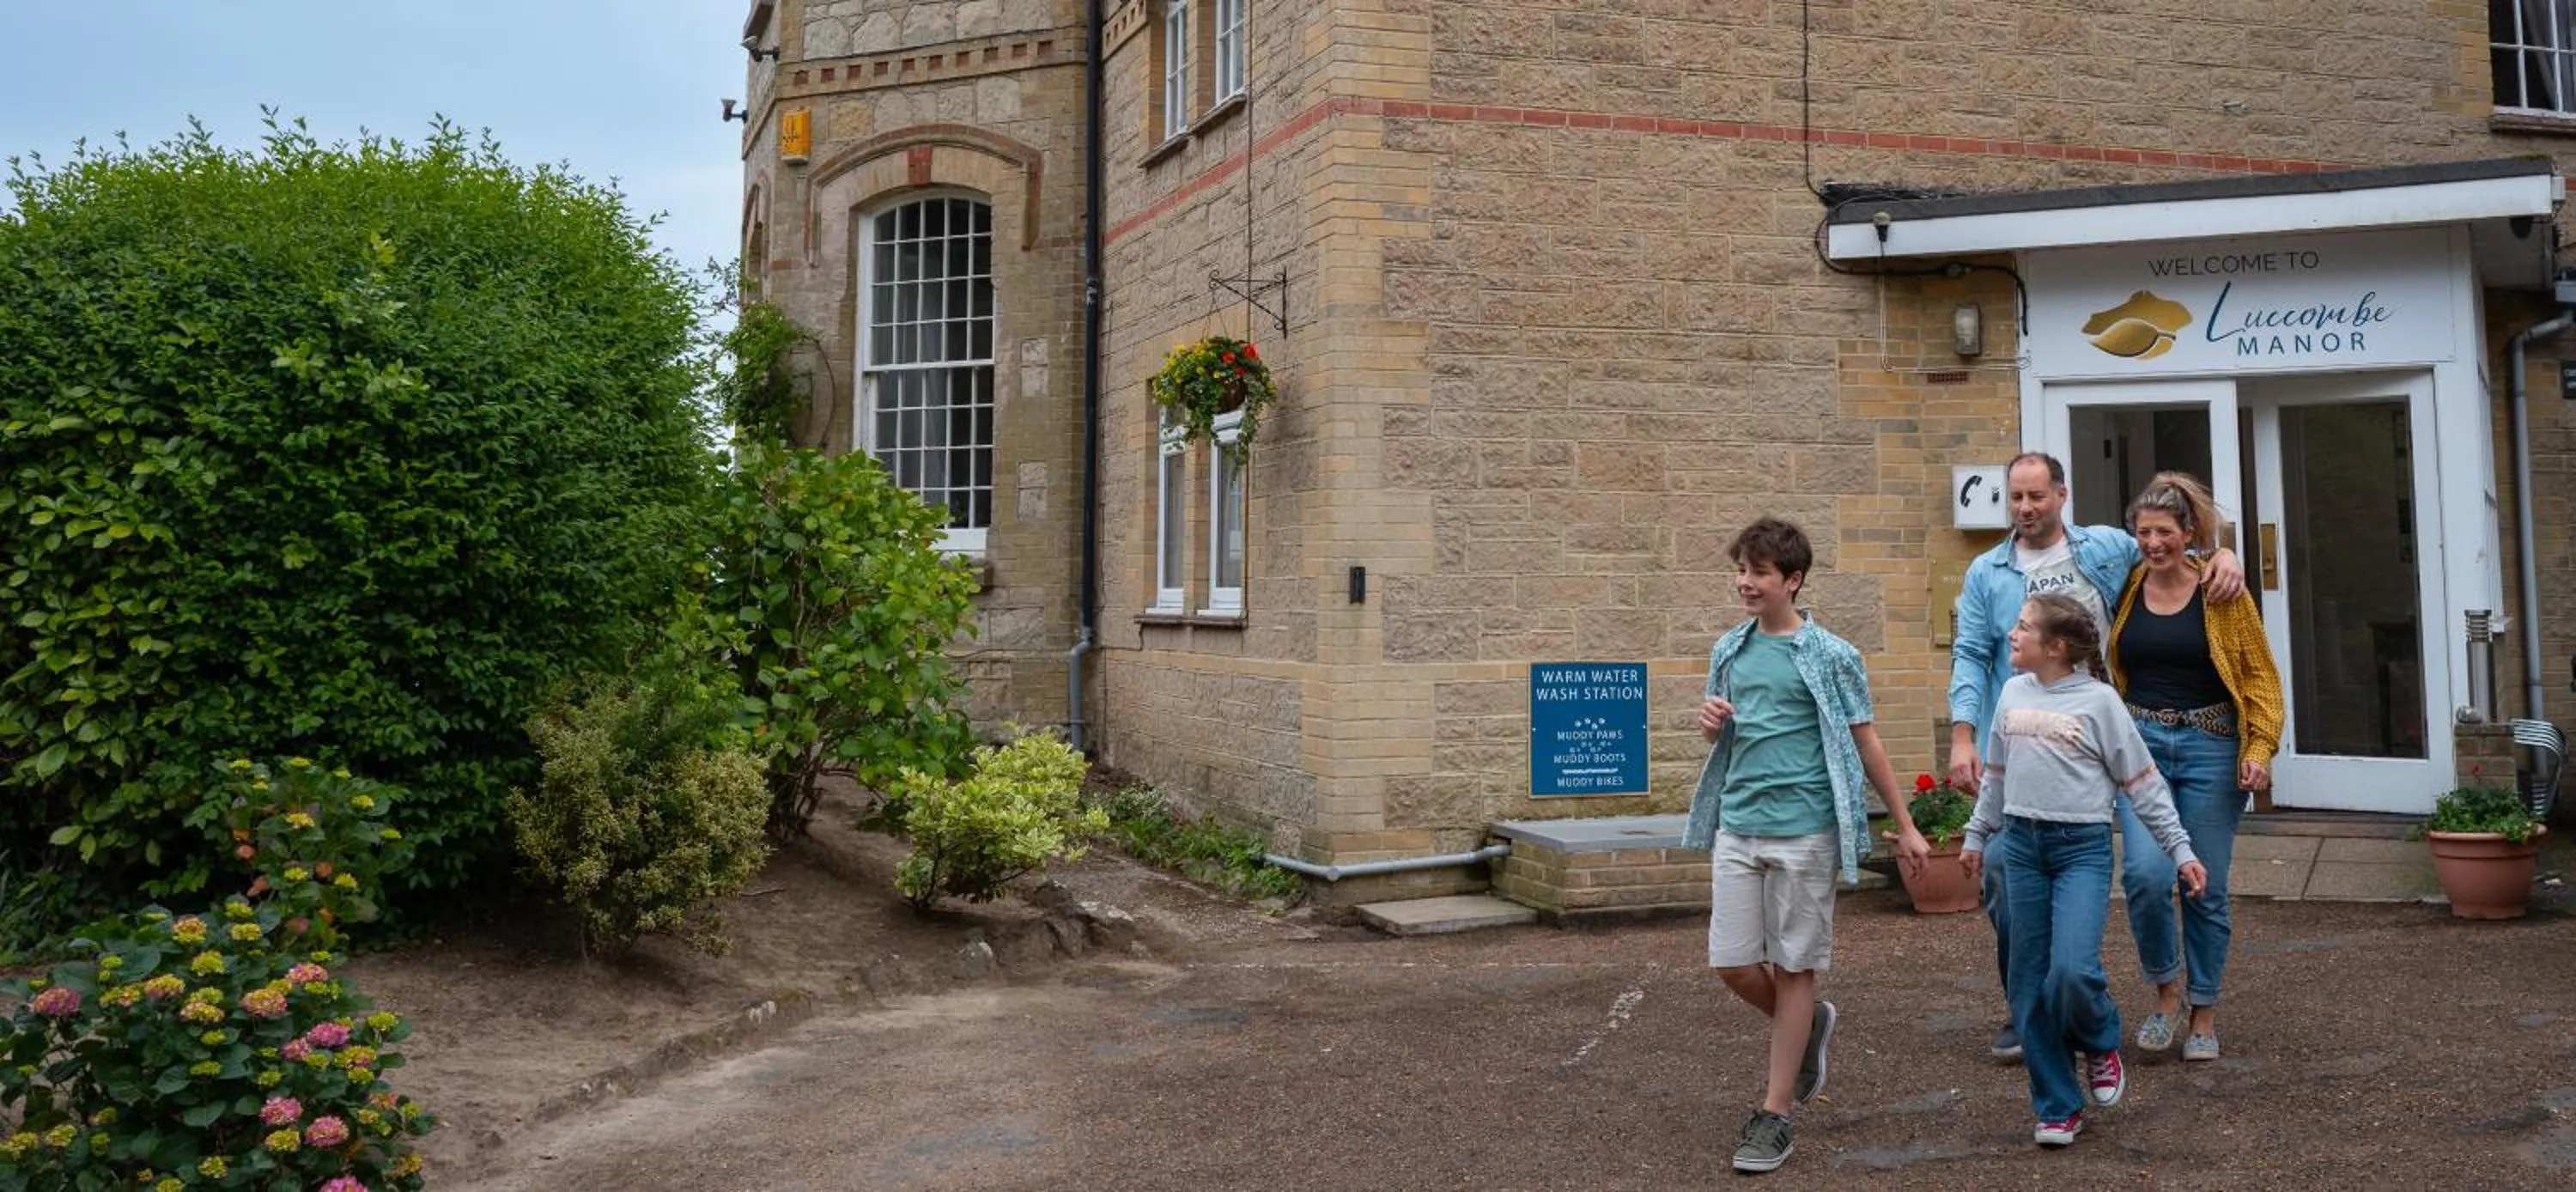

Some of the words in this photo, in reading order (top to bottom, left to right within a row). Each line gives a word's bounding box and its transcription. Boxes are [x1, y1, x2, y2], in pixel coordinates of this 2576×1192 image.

[2148, 252, 2276, 277] WELCOME
[2286, 251, 2320, 270] TO
[2205, 280, 2392, 343] Luccombe
[2236, 331, 2366, 356] MANOR
[2028, 572, 2075, 593] APAN
[1541, 670, 1586, 684] WARM
[1591, 669, 1638, 684] WATER
[1536, 688, 1577, 701] WASH
[1583, 686, 1643, 700] STATION
[1557, 732, 1594, 740] MUDDY
[1596, 730, 1624, 739] PAWS
[1554, 754, 1590, 763] MUDDY
[1593, 752, 1626, 763] BOOTS
[1557, 778, 1594, 788] MUDDY
[1596, 776, 1624, 786] BIKES
